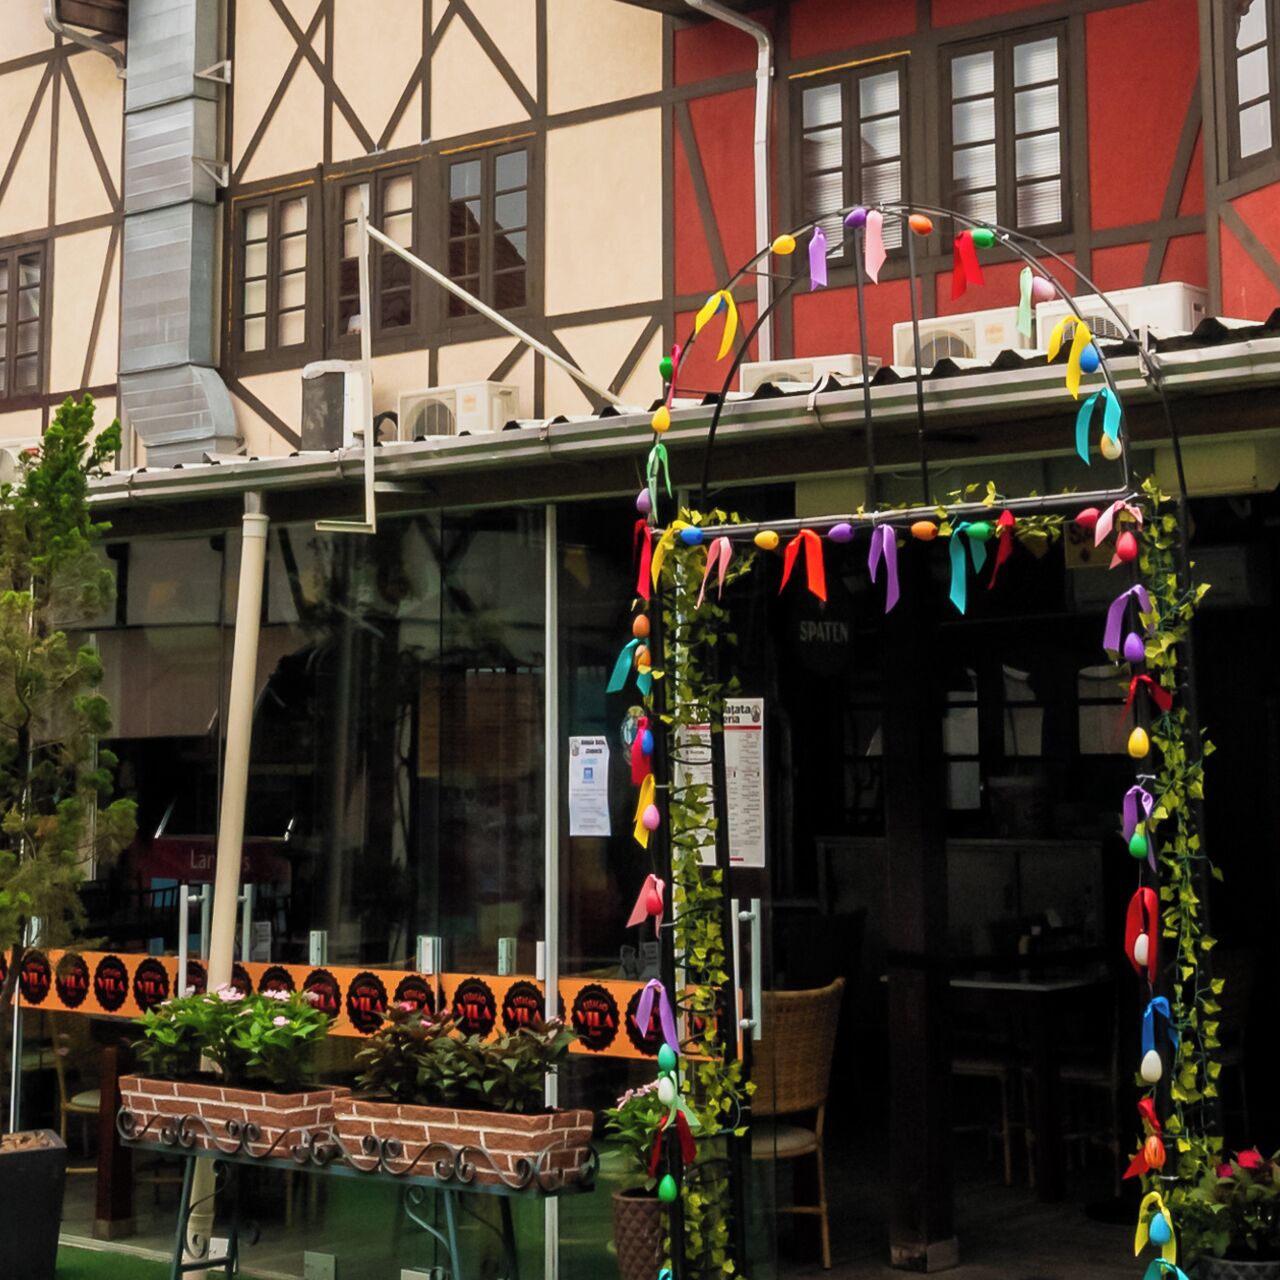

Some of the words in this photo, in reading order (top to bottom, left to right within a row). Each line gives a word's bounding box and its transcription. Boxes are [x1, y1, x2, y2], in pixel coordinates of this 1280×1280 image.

[800, 620, 849, 642] SPATEN
[351, 996, 383, 1012] VILA
[457, 1003, 491, 1020] VILA
[507, 1007, 541, 1024] VILA
[576, 1010, 613, 1028] VILA
